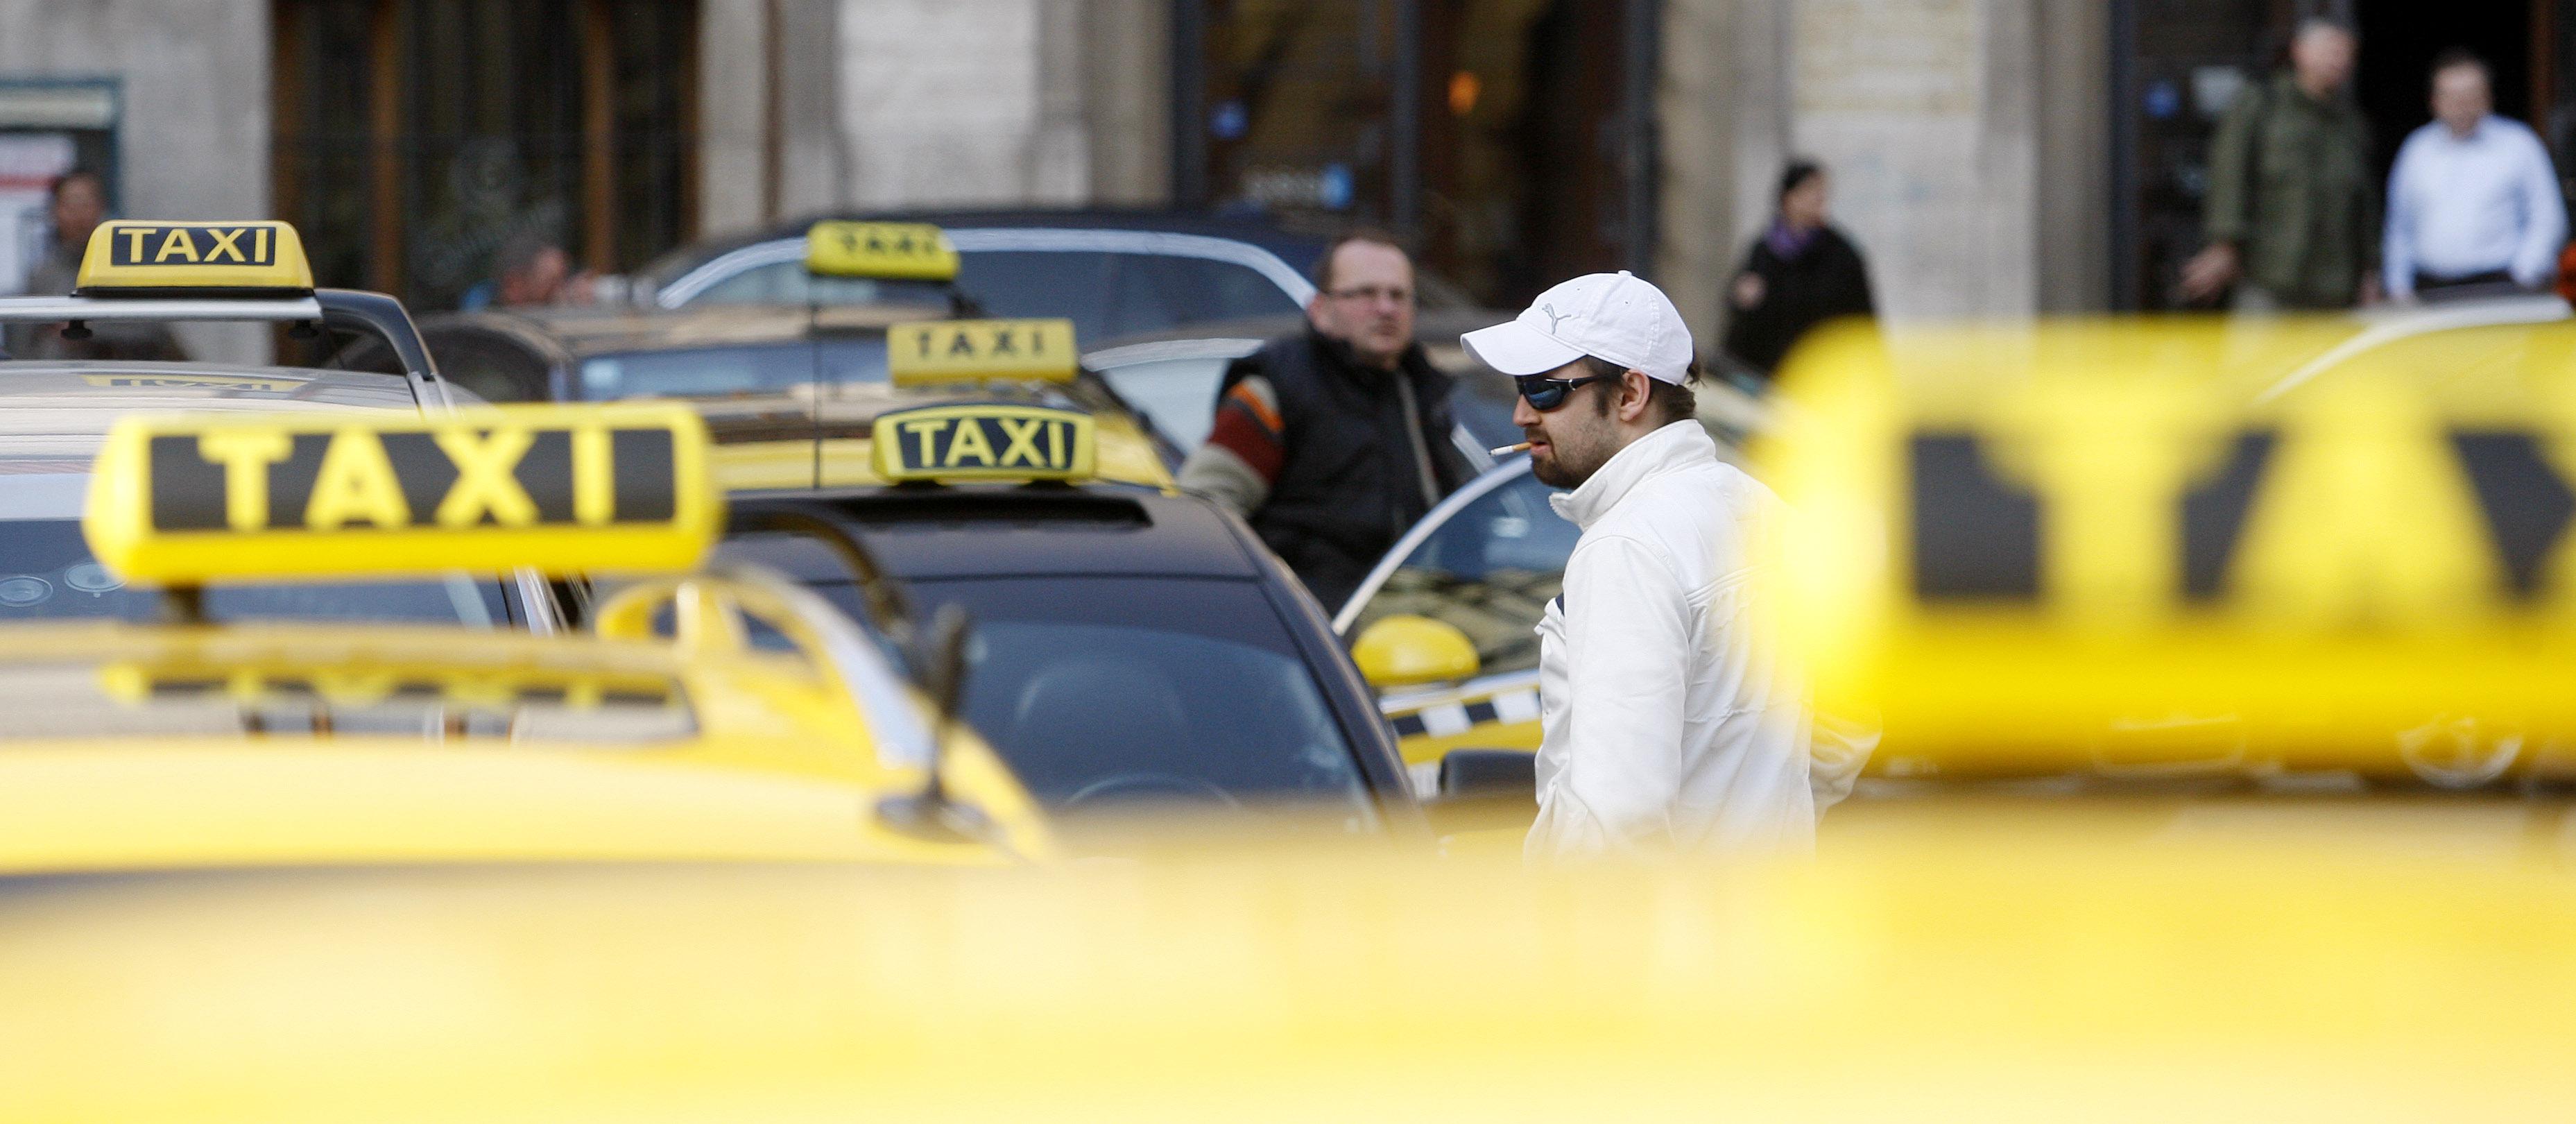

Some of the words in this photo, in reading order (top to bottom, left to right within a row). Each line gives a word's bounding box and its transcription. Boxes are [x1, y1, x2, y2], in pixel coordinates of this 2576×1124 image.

[118, 228, 268, 263] TAXI
[915, 330, 1044, 358] TAXI
[904, 416, 1067, 468] TAXI
[196, 426, 615, 531] TAXI
